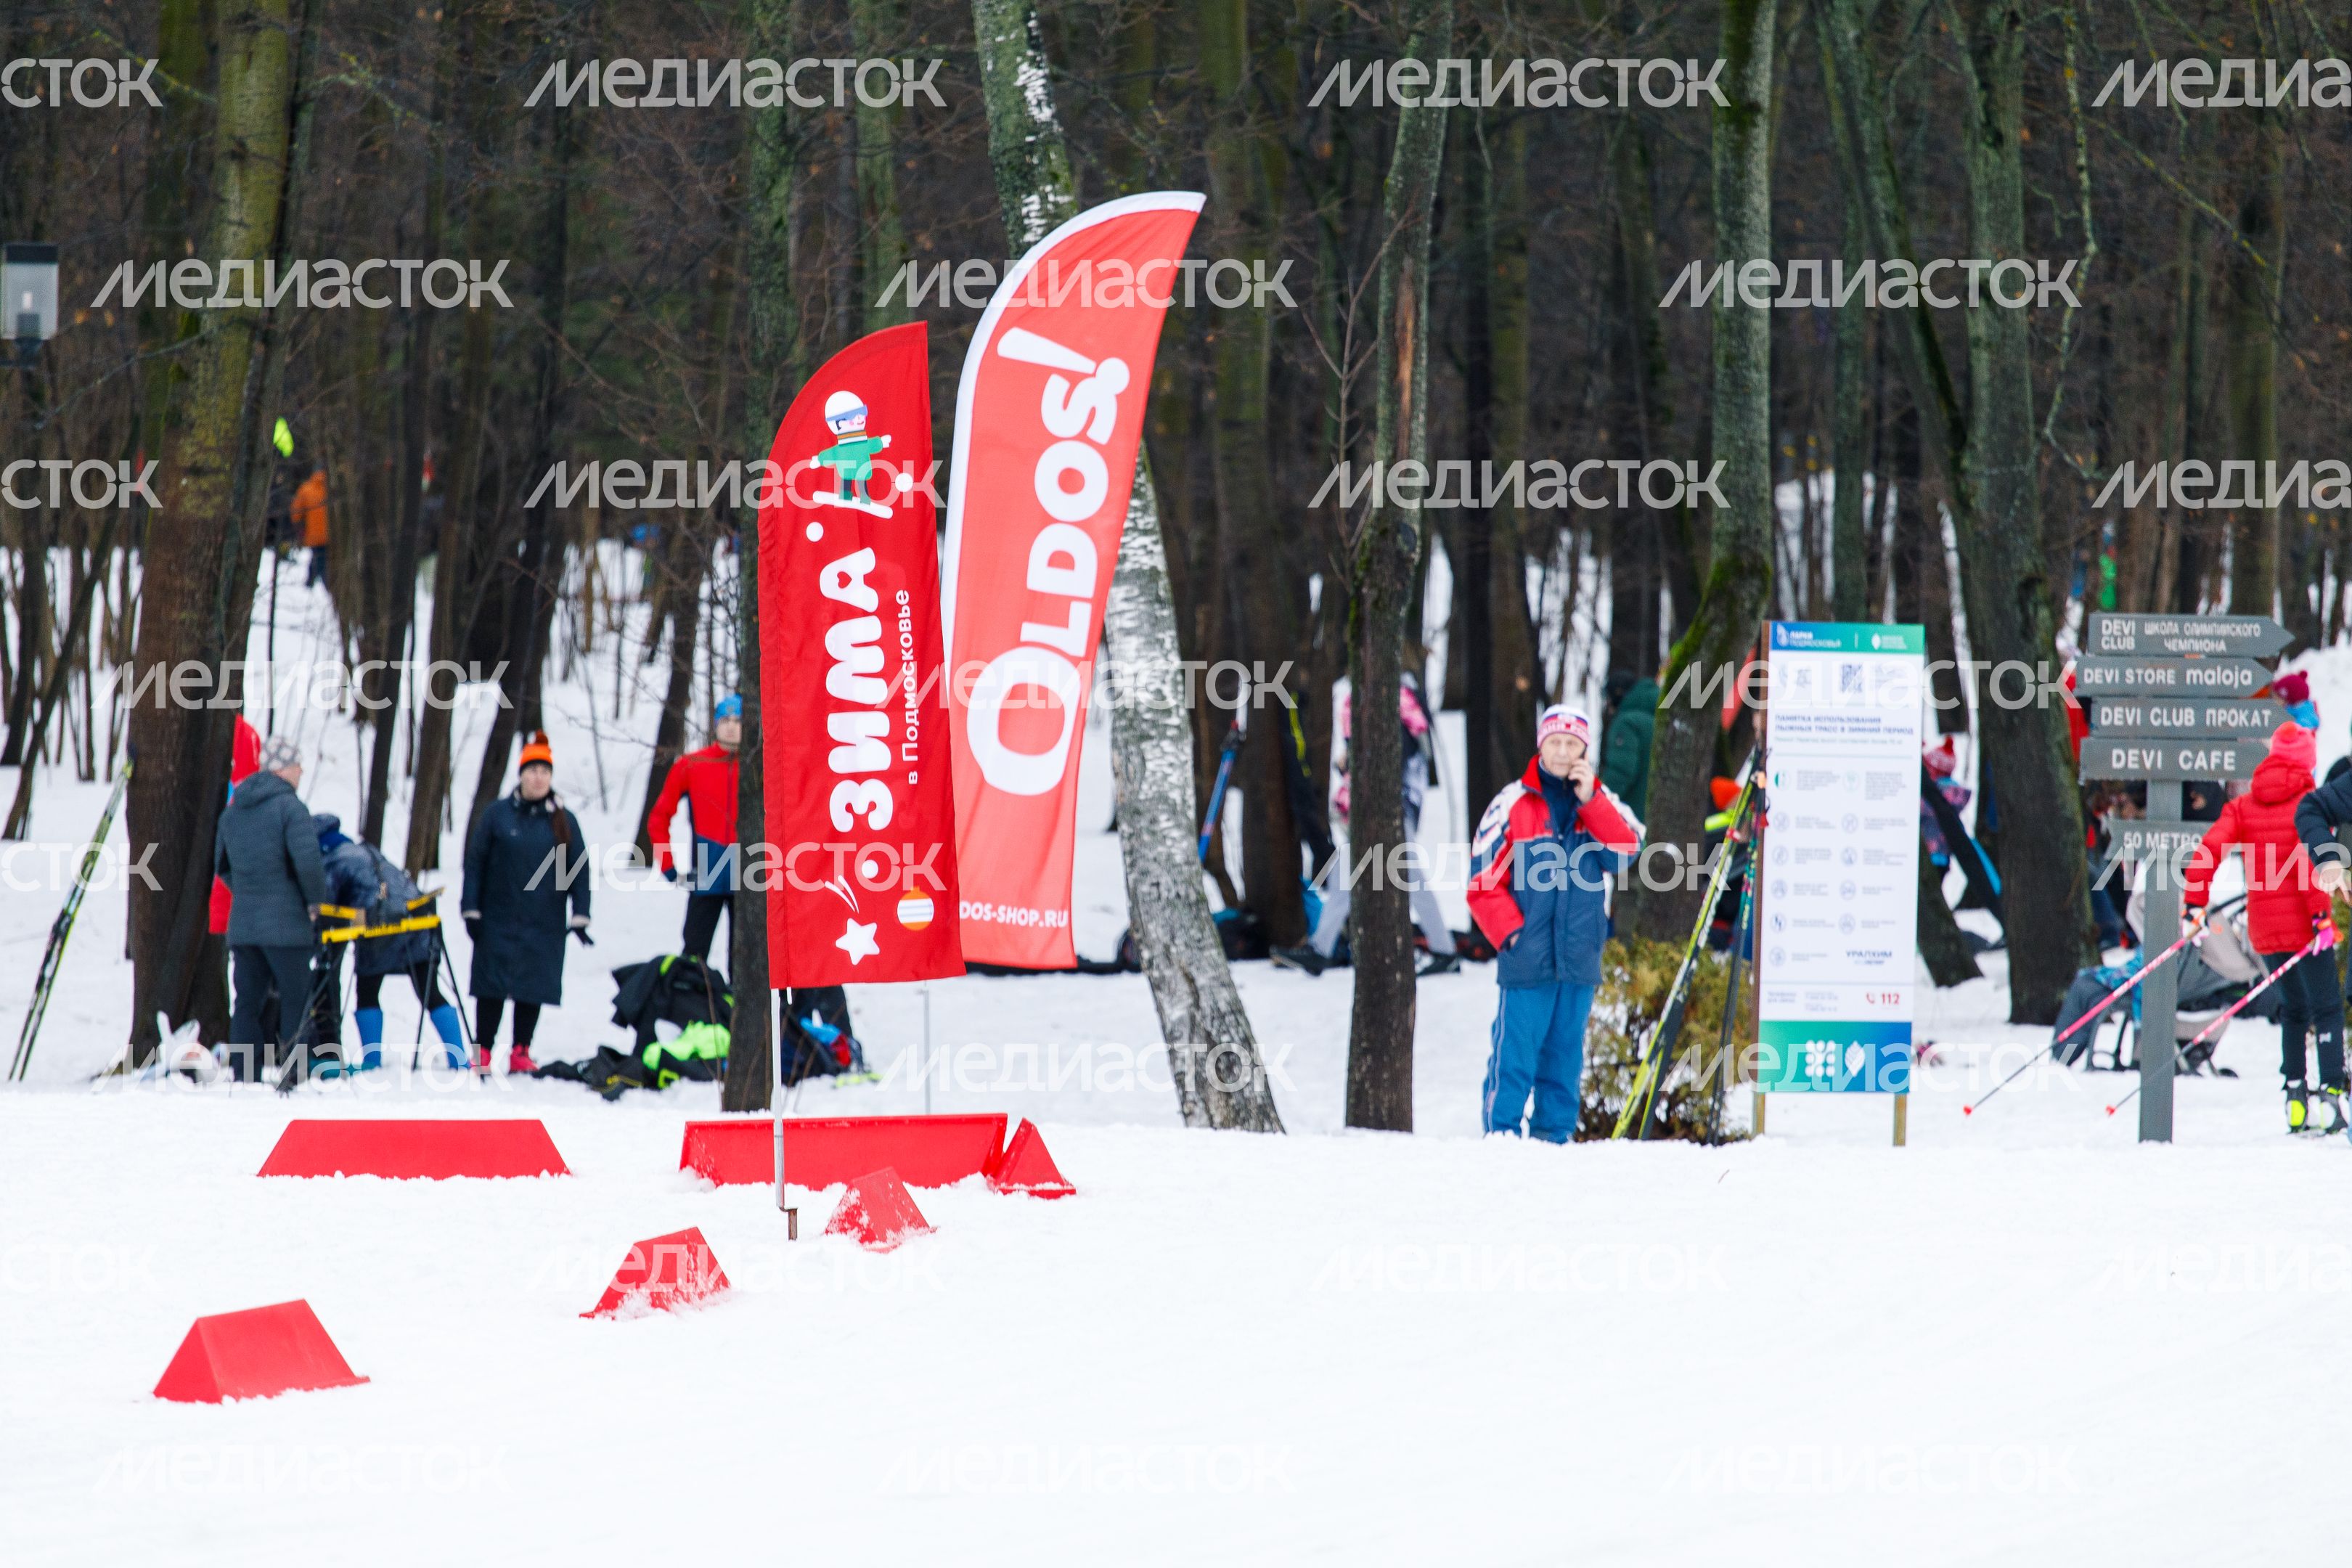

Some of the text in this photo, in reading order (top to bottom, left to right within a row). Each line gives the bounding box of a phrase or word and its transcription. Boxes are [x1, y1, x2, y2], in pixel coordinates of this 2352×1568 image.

[2102, 619, 2136, 636] DEVI
[2144, 621, 2179, 635] ШКОЛА
[2101, 636, 2136, 650] CLUB
[2164, 639, 2226, 653] ЧЕМПИОНА
[2083, 666, 2253, 688] DEVI STORE maloja
[896, 589, 919, 785] в Подмосковье
[2100, 707, 2271, 727] DEVI CLUB ПРОКАТ
[2111, 748, 2236, 771] DEVI CAFE
[2123, 831, 2203, 850] 50 МЕТРО
[960, 901, 1069, 928] DOS-SHOP.RU
[1881, 993, 1900, 1005] 112
